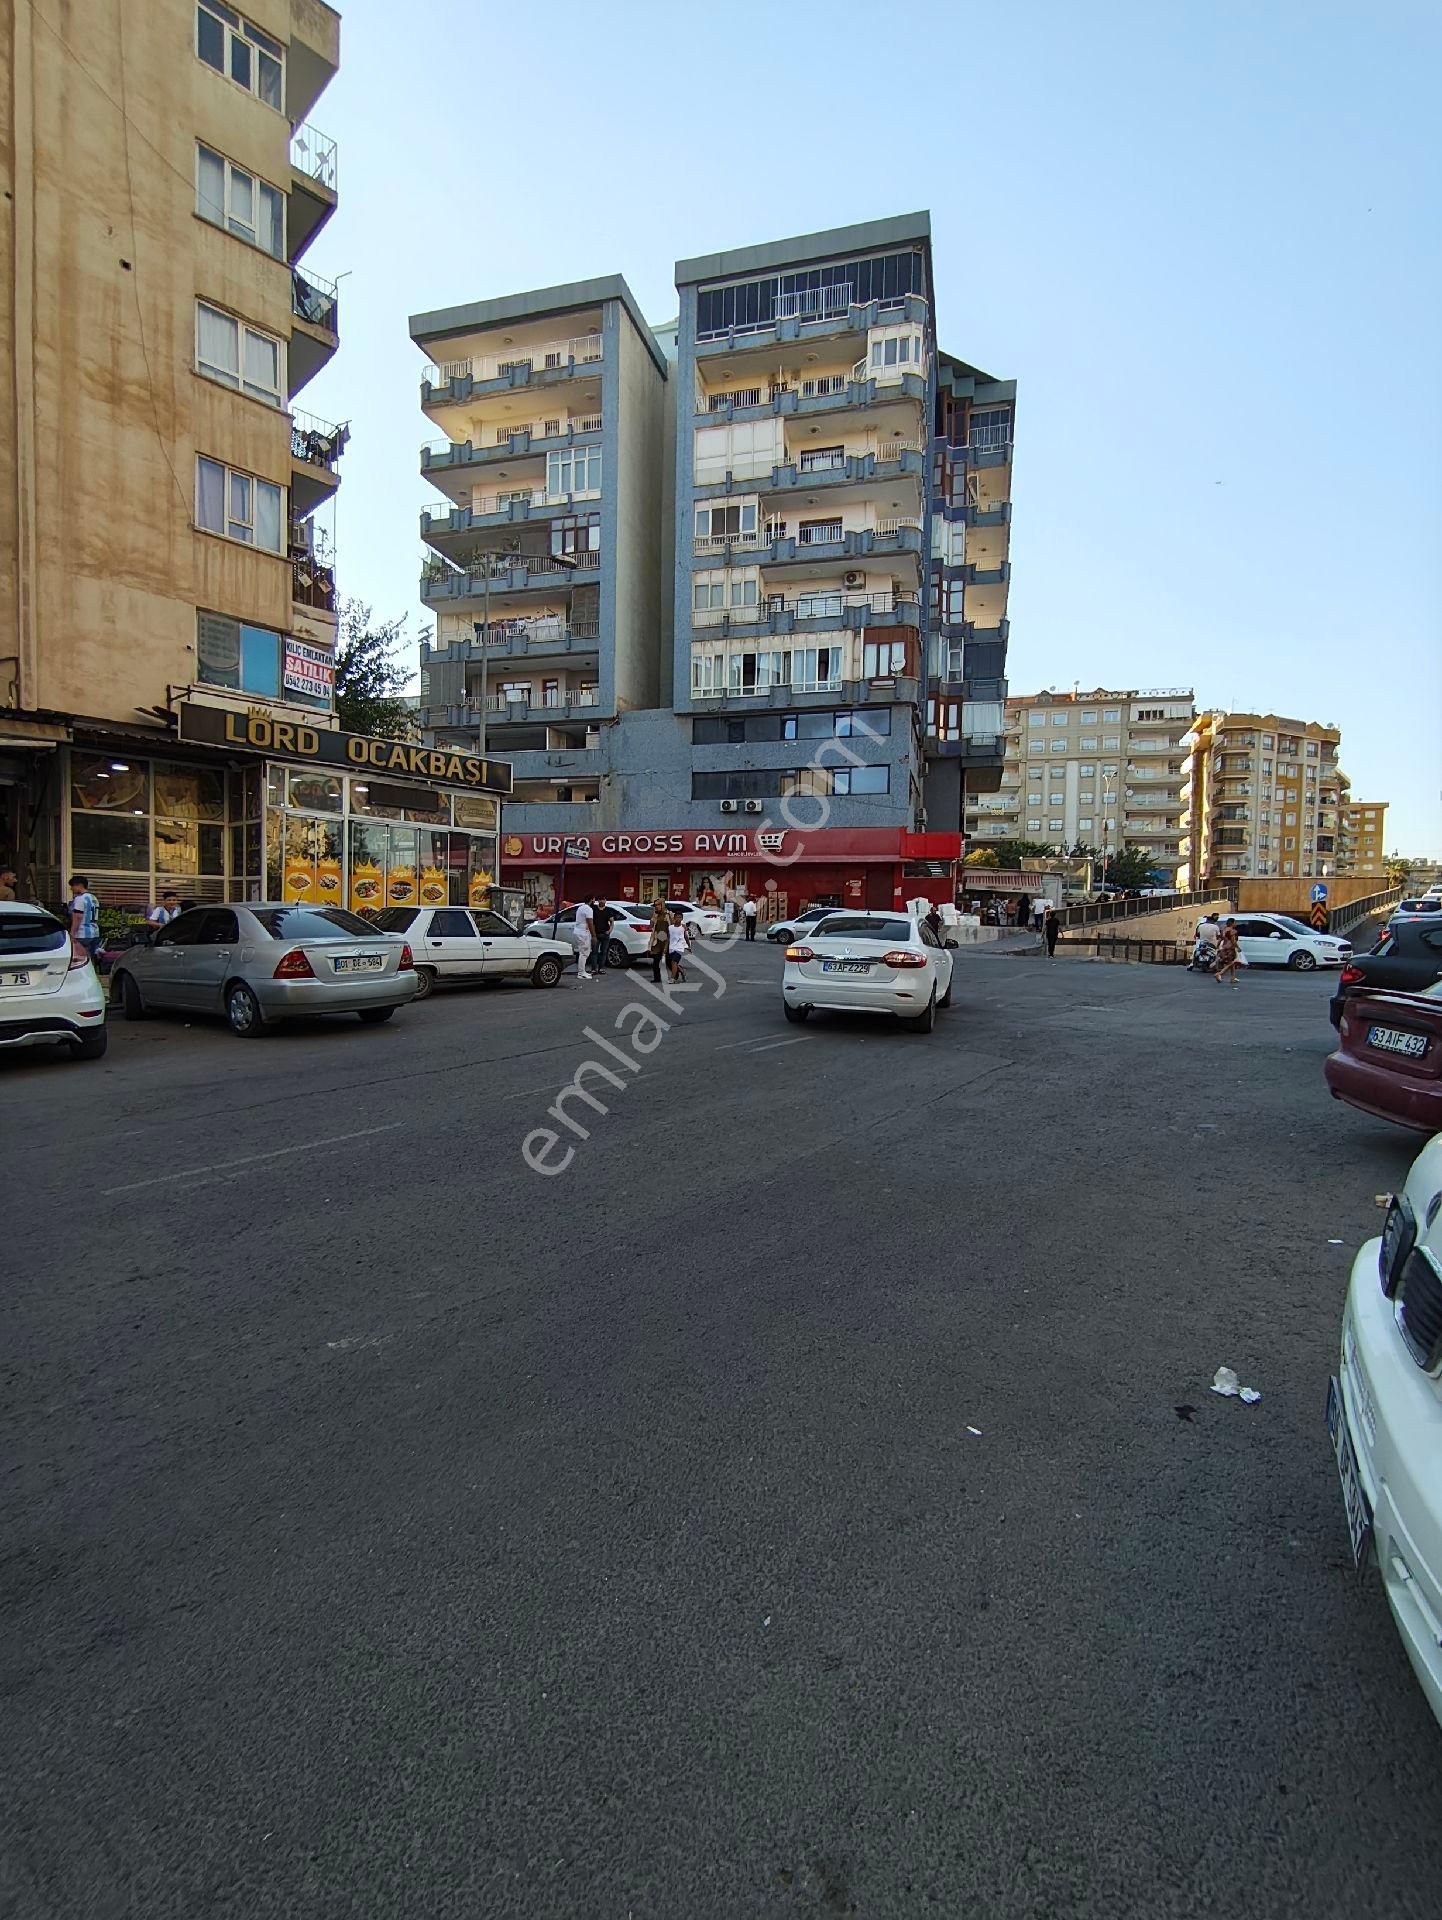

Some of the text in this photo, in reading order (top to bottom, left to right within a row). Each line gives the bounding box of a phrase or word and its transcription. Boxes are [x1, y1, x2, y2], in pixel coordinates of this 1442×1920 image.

[285, 656, 332, 684] SATILIK
[285, 673, 300, 689] 0542
[301, 678, 313, 692] 273
[225, 712, 488, 785] LORD OCAKBAŞI
[601, 835, 684, 853] GROSS
[695, 834, 747, 851] AVM
[11, 974, 27, 984] 75
[1373, 1028, 1385, 1043] 63
[1405, 1036, 1424, 1052] 432
